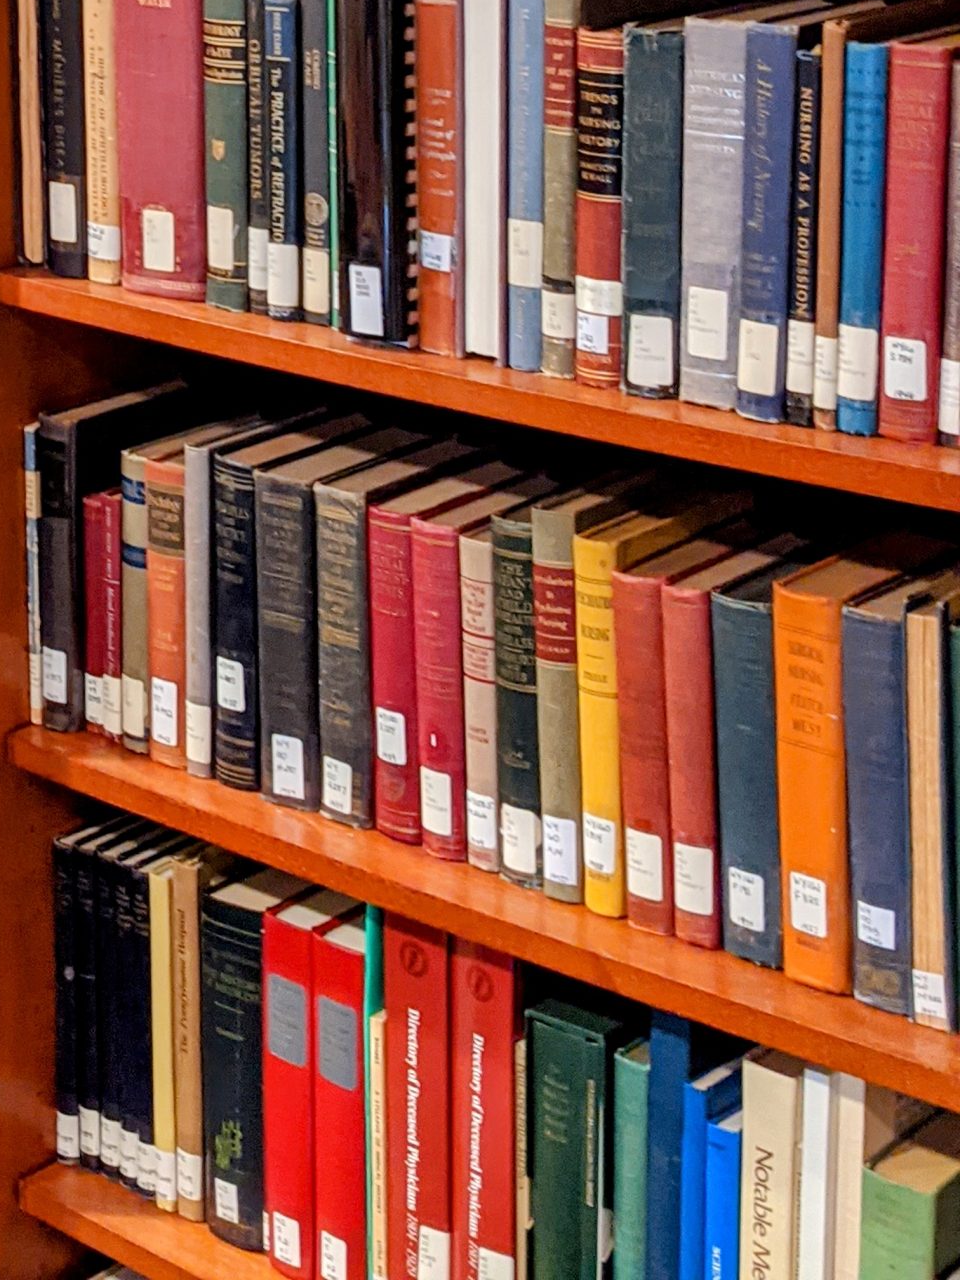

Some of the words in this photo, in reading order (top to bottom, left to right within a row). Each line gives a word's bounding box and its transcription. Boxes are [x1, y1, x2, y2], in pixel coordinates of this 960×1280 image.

[248, 39, 263, 118] ORBITAL
[271, 68, 282, 87] The
[754, 78, 774, 138] History
[270, 91, 284, 153] PRACTICE
[799, 86, 814, 164] NURSING
[250, 124, 263, 200] TUMORS
[799, 171, 810, 191] AS
[271, 171, 285, 242] REFRACTIO
[799, 198, 810, 209] A
[795, 216, 810, 316] PROFESSION
[405, 1007, 420, 1067] Directory
[470, 1033, 485, 1094] Directory
[407, 1069, 421, 1087] of
[471, 1096, 485, 1114] of
[406, 1086, 420, 1144] Deceased
[469, 1114, 483, 1170] Deceased
[404, 1146, 420, 1211] Physicians
[466, 1172, 483, 1238] Physicians
[752, 1146, 774, 1236] Notable
